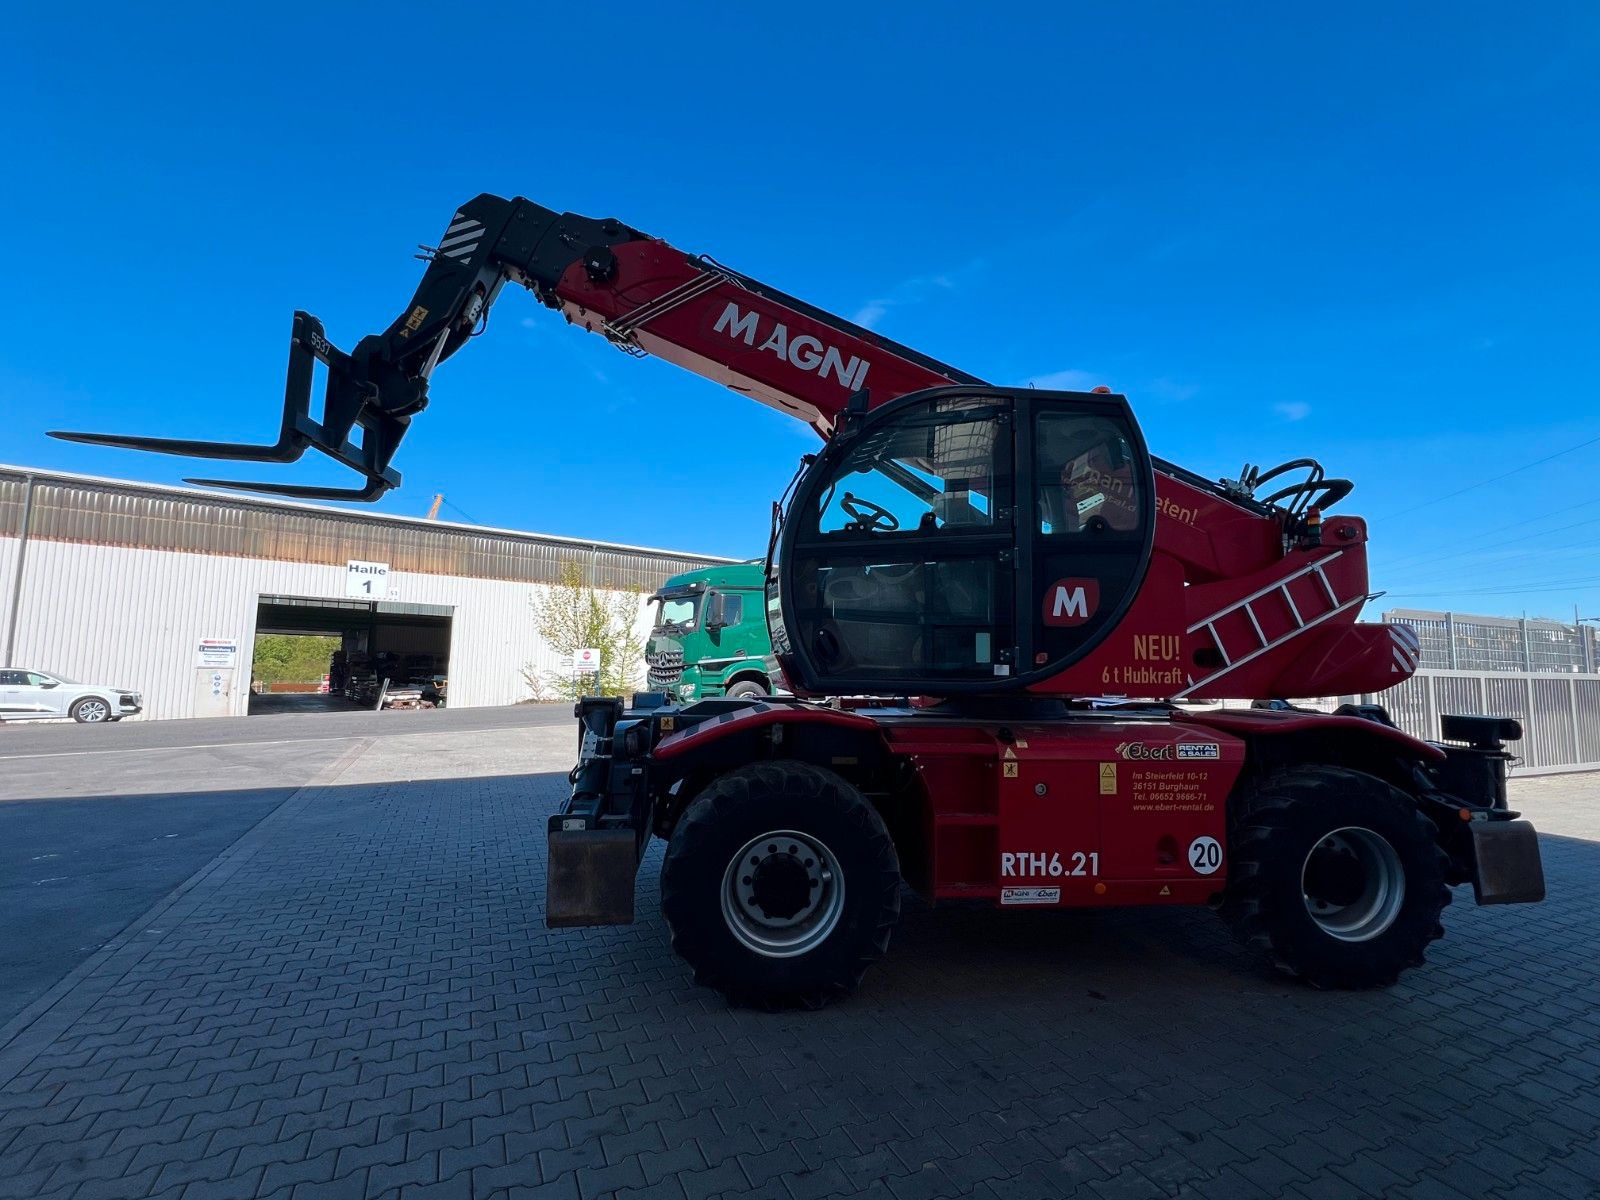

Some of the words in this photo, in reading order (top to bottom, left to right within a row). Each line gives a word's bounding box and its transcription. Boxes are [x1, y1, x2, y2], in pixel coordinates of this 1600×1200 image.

[311, 331, 331, 355] 5537
[713, 302, 871, 392] MAGNI
[349, 564, 387, 576] Halle
[362, 580, 372, 594] 1
[1052, 586, 1089, 618] M
[1133, 634, 1180, 661] NEU!
[1102, 666, 1110, 683] 6
[1113, 667, 1120, 683] t
[1123, 666, 1183, 684] Hubkraft
[1122, 742, 1174, 760] Ebert
[1132, 772, 1143, 780] Im
[1145, 772, 1185, 780] Steierfeld
[1186, 772, 1208, 780] 10-12
[1132, 782, 1157, 790] 36151
[1159, 782, 1200, 792] Burghaun
[1149, 793, 1174, 801] 06652
[1133, 803, 1215, 811] www.ebert-rental.de
[1193, 842, 1220, 868] 20
[1001, 852, 1099, 877] RTH6.21
